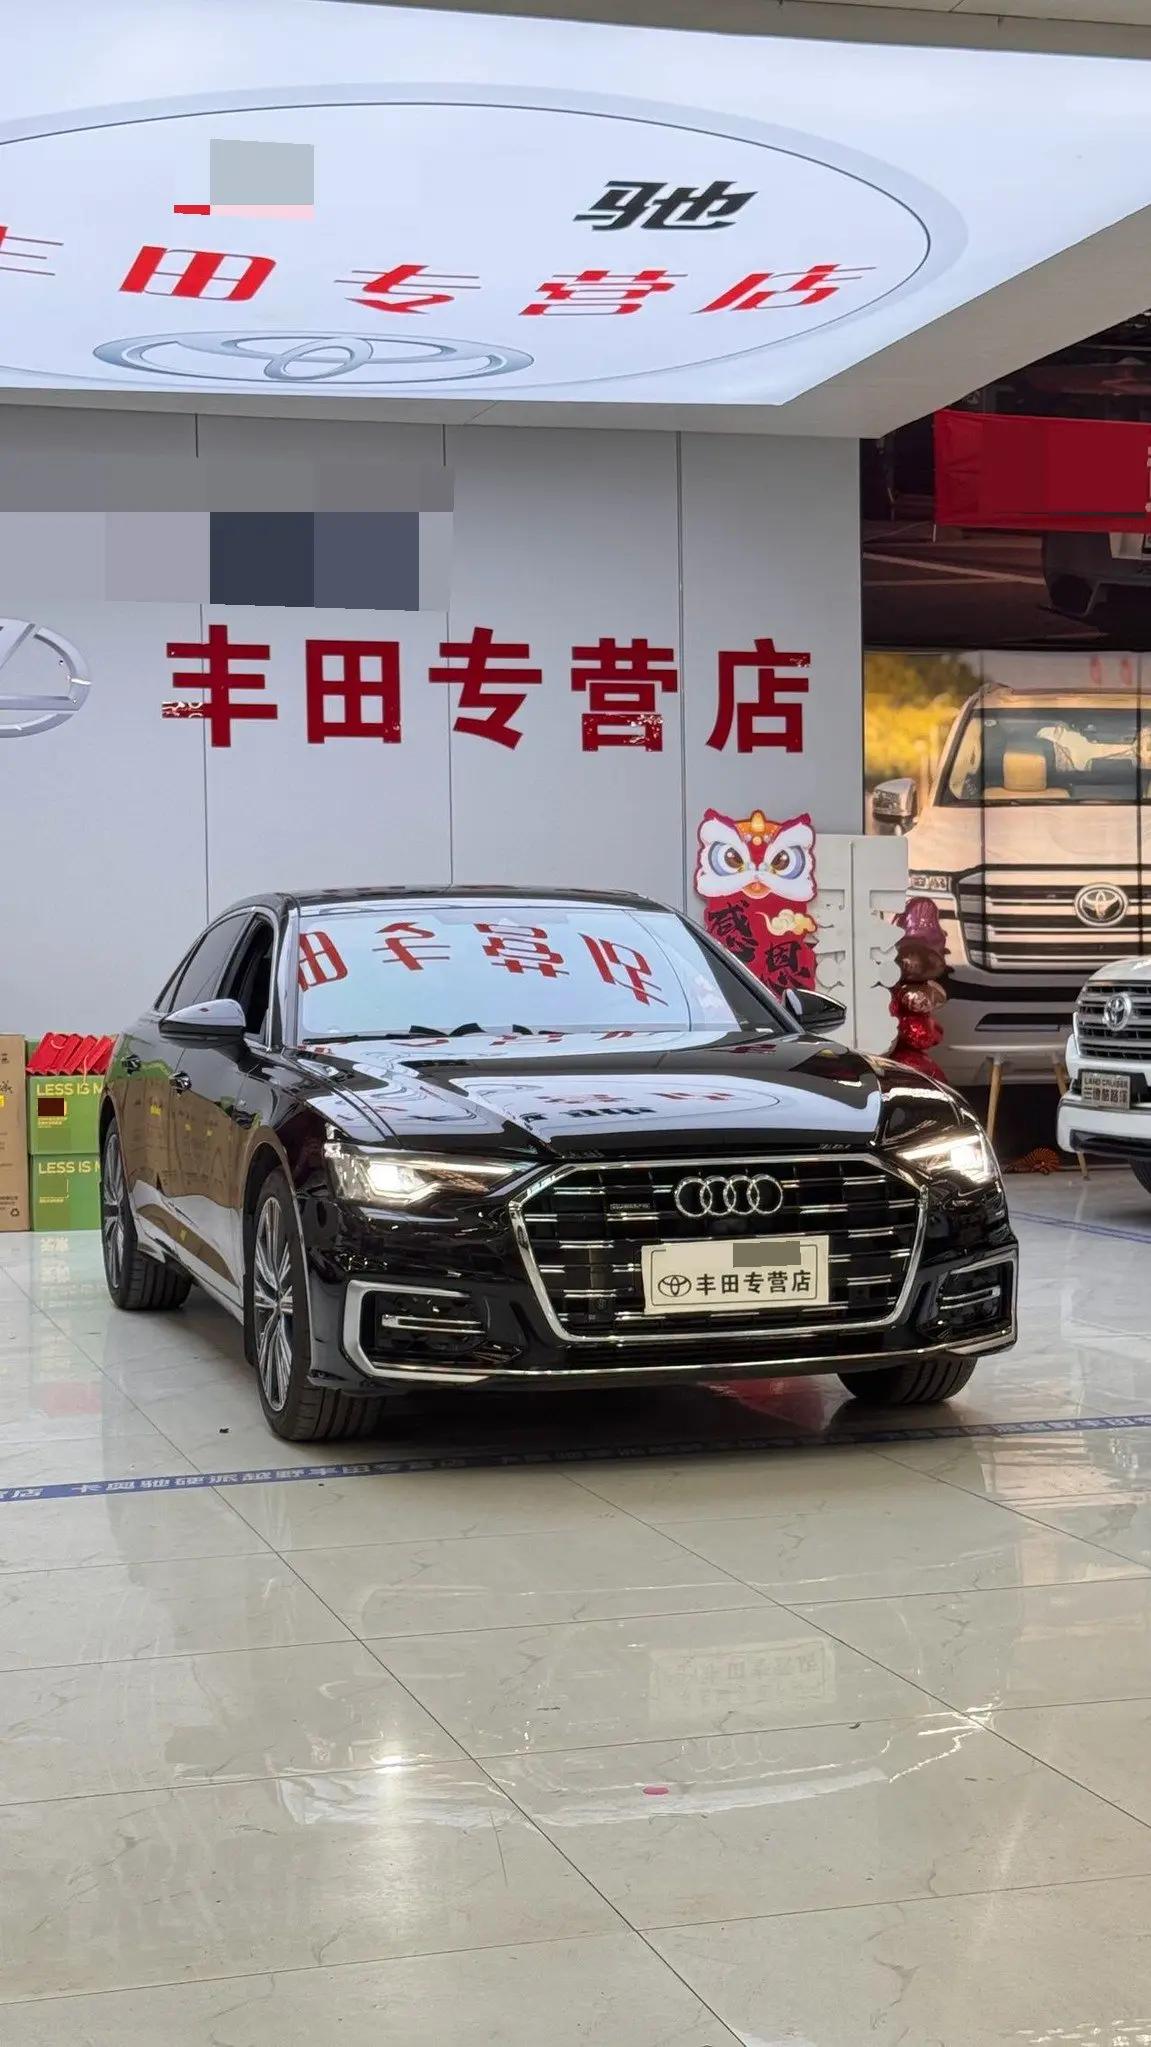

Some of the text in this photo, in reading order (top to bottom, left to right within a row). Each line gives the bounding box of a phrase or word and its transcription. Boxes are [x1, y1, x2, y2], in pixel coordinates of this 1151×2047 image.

[574, 180, 757, 231] 驰
[162, 624, 812, 754] 丰田专营店
[36, 1083, 74, 1096] LESS
[77, 1082, 90, 1095] IS
[38, 1161, 76, 1174] LESS
[78, 1160, 92, 1173] IS
[696, 1269, 811, 1296] 丰田专营店
